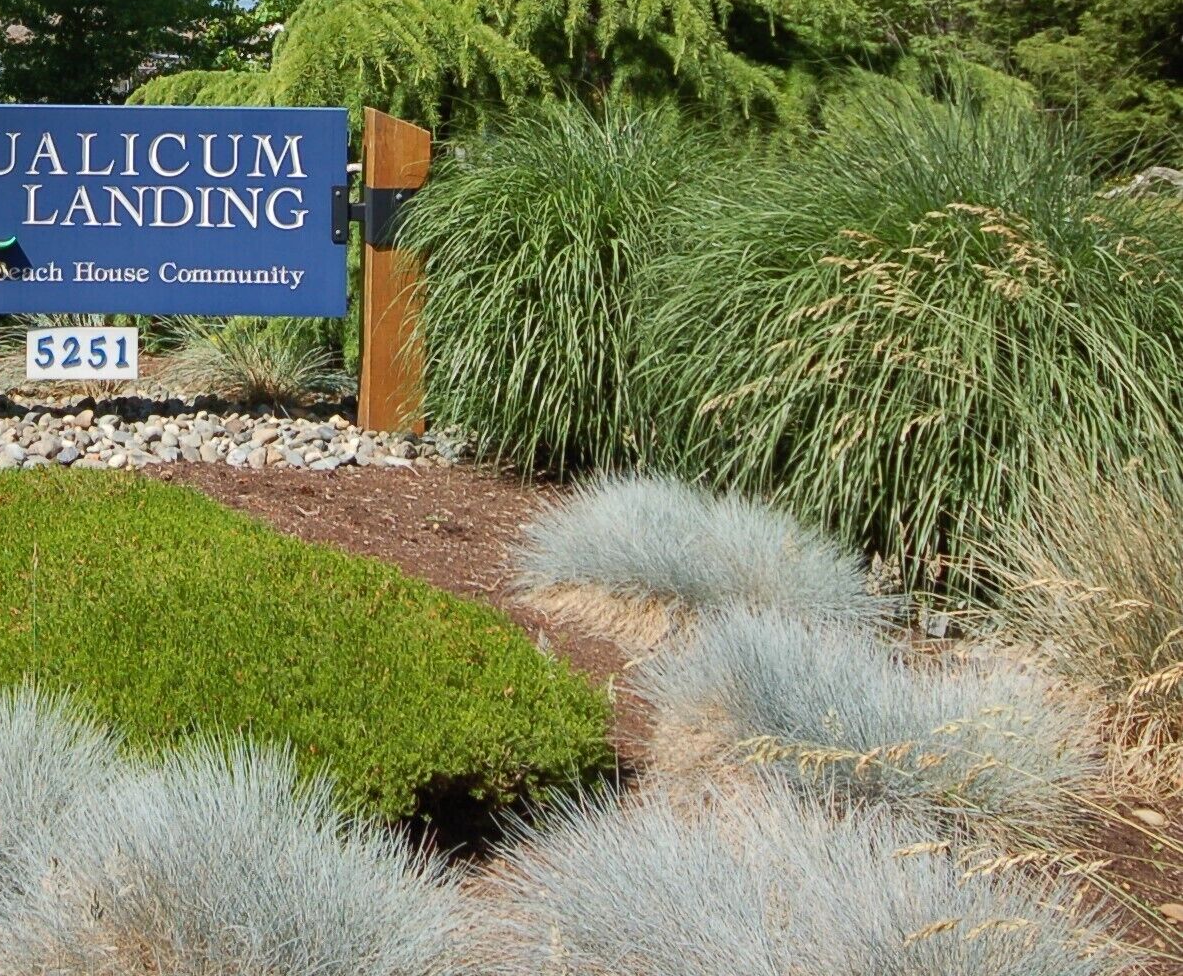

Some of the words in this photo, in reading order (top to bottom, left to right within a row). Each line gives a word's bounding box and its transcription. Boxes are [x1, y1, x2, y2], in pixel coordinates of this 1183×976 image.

[21, 184, 310, 230] LANDING
[72, 261, 150, 282] House
[158, 262, 305, 290] Community
[34, 335, 130, 370] 5251
